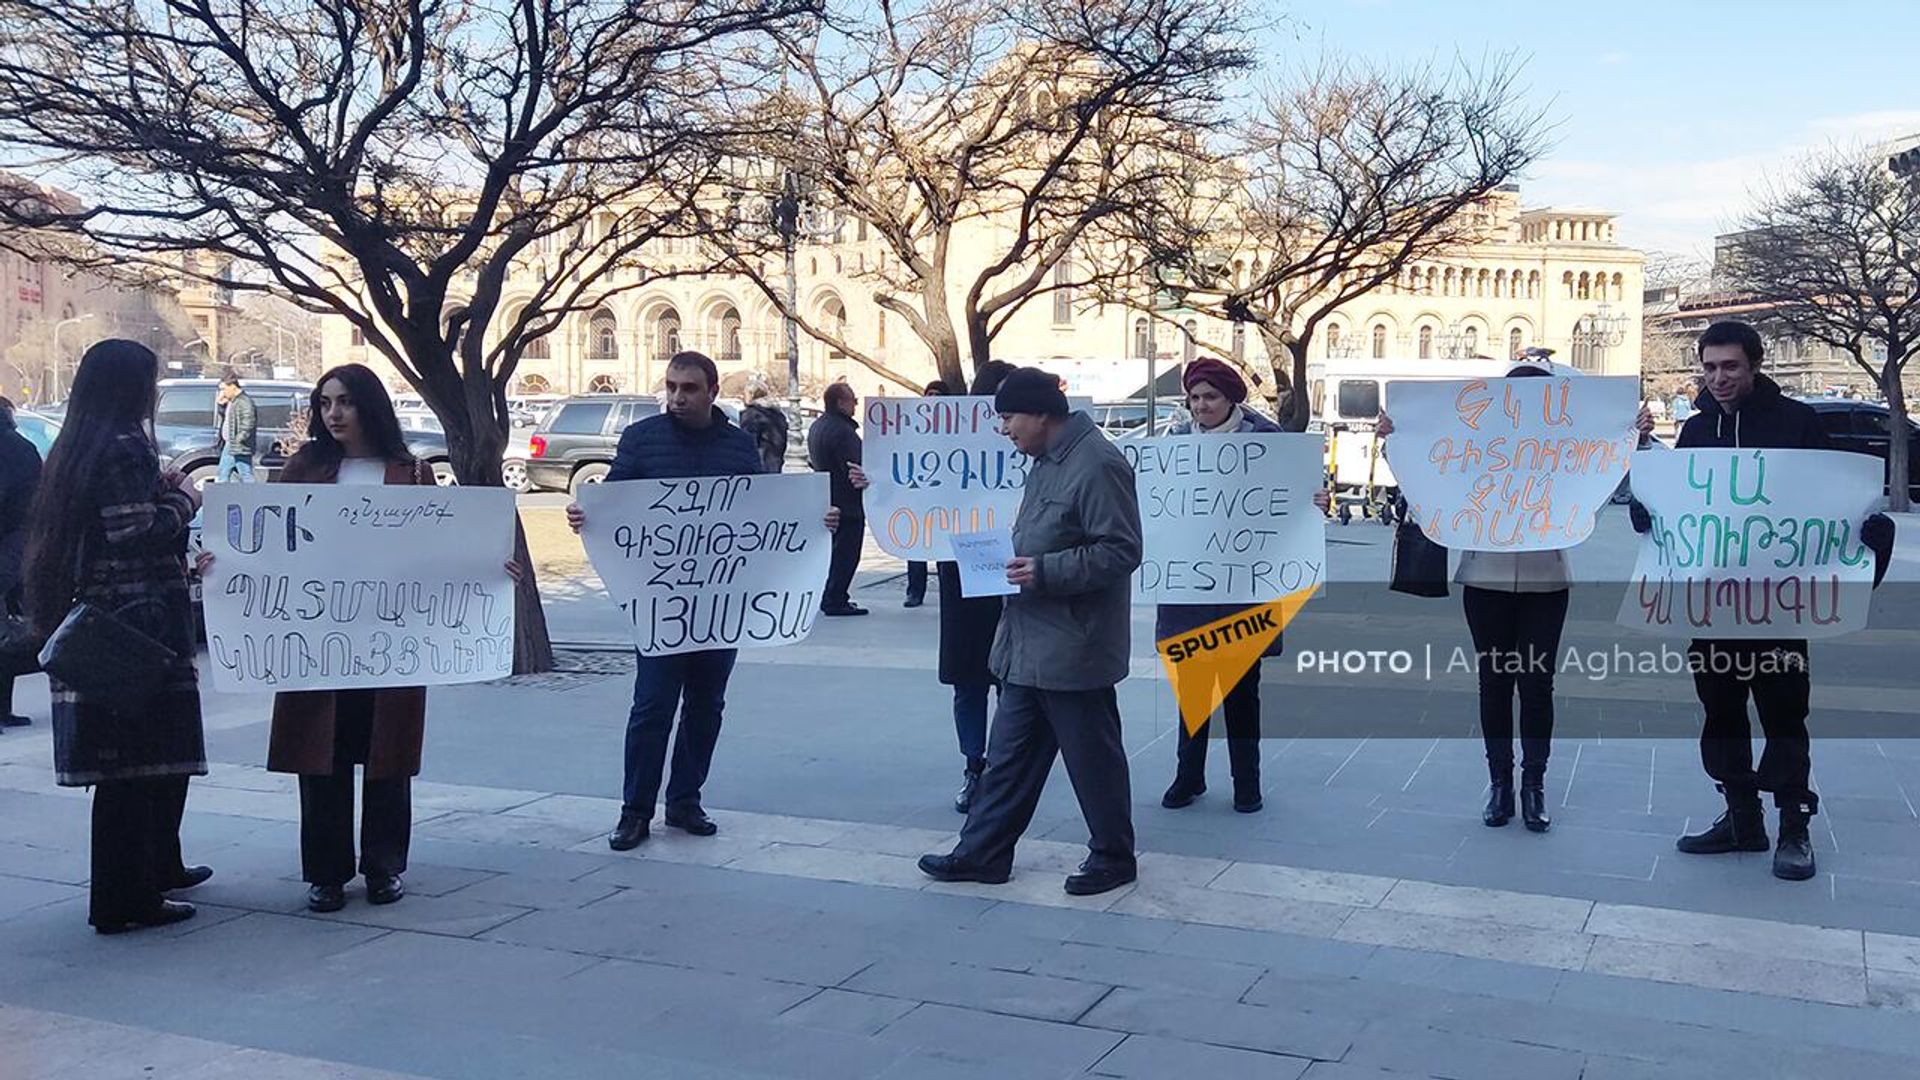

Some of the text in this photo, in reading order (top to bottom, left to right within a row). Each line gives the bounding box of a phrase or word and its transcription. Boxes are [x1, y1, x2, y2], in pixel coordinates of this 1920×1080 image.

[869, 401, 1004, 435] ԳԻՏՈՒԹ
[892, 449, 1028, 489] ԱԶԳԱՅ
[1124, 442, 1267, 475] DEVELOP
[1150, 486, 1289, 519] SCIENCE
[614, 521, 807, 558] ԳԻՏՈՒԹՅՈՒՆ
[1205, 529, 1278, 553] NOT
[1140, 560, 1321, 597] DESTROY
[226, 573, 509, 636] ՊԱՏՄԱԿԱՆ
[1686, 574, 1841, 628] ԱՊԱԳԱ
[620, 591, 813, 652] ԱՅԱՍՏԱՆ
